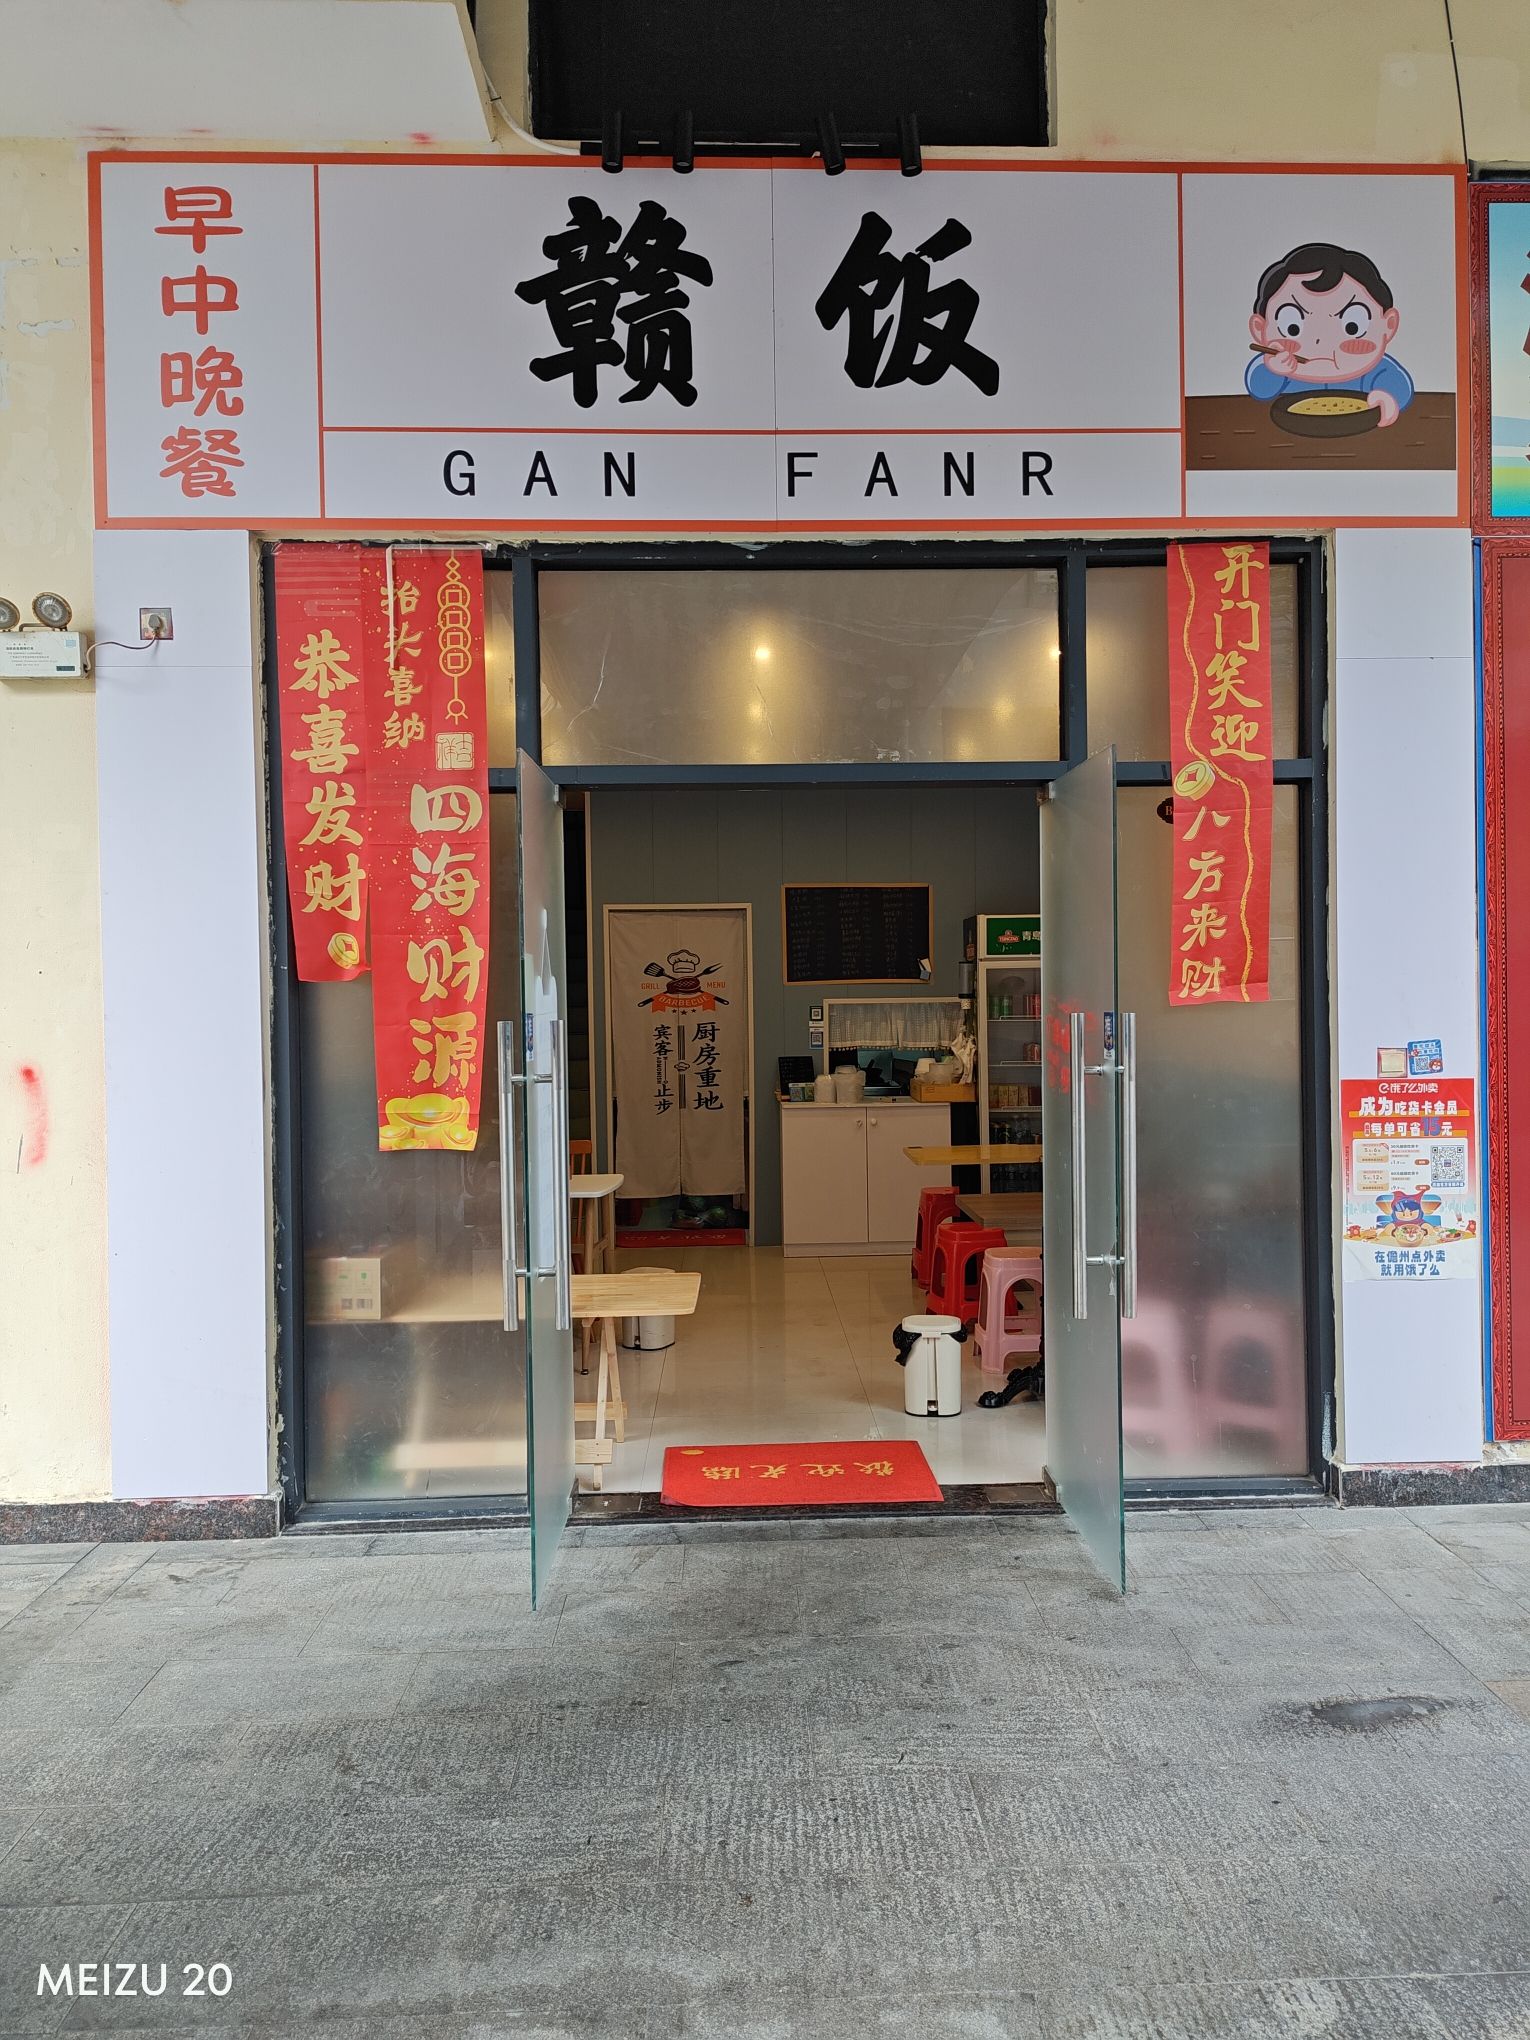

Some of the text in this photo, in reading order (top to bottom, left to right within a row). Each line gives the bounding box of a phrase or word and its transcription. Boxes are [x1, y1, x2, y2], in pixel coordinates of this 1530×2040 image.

[154, 186, 244, 498] 早中晚餐
[514, 195, 1000, 408] 赣饭
[443, 449, 1055, 497] GAN FANR
[1206, 545, 1266, 762] 开门笑迎
[289, 628, 366, 922] 恭喜发财
[407, 783, 484, 1089] 四海财源
[1179, 806, 1231, 999] 八方来财
[641, 981, 726, 990] GRILL MENU
[658, 995, 710, 1008] BARBECUE
[691, 1021, 724, 1110] 厨房重地
[1359, 1096, 1458, 1117] 成为吃货卡会员
[1381, 1264, 1440, 1277] 就用饿了么
